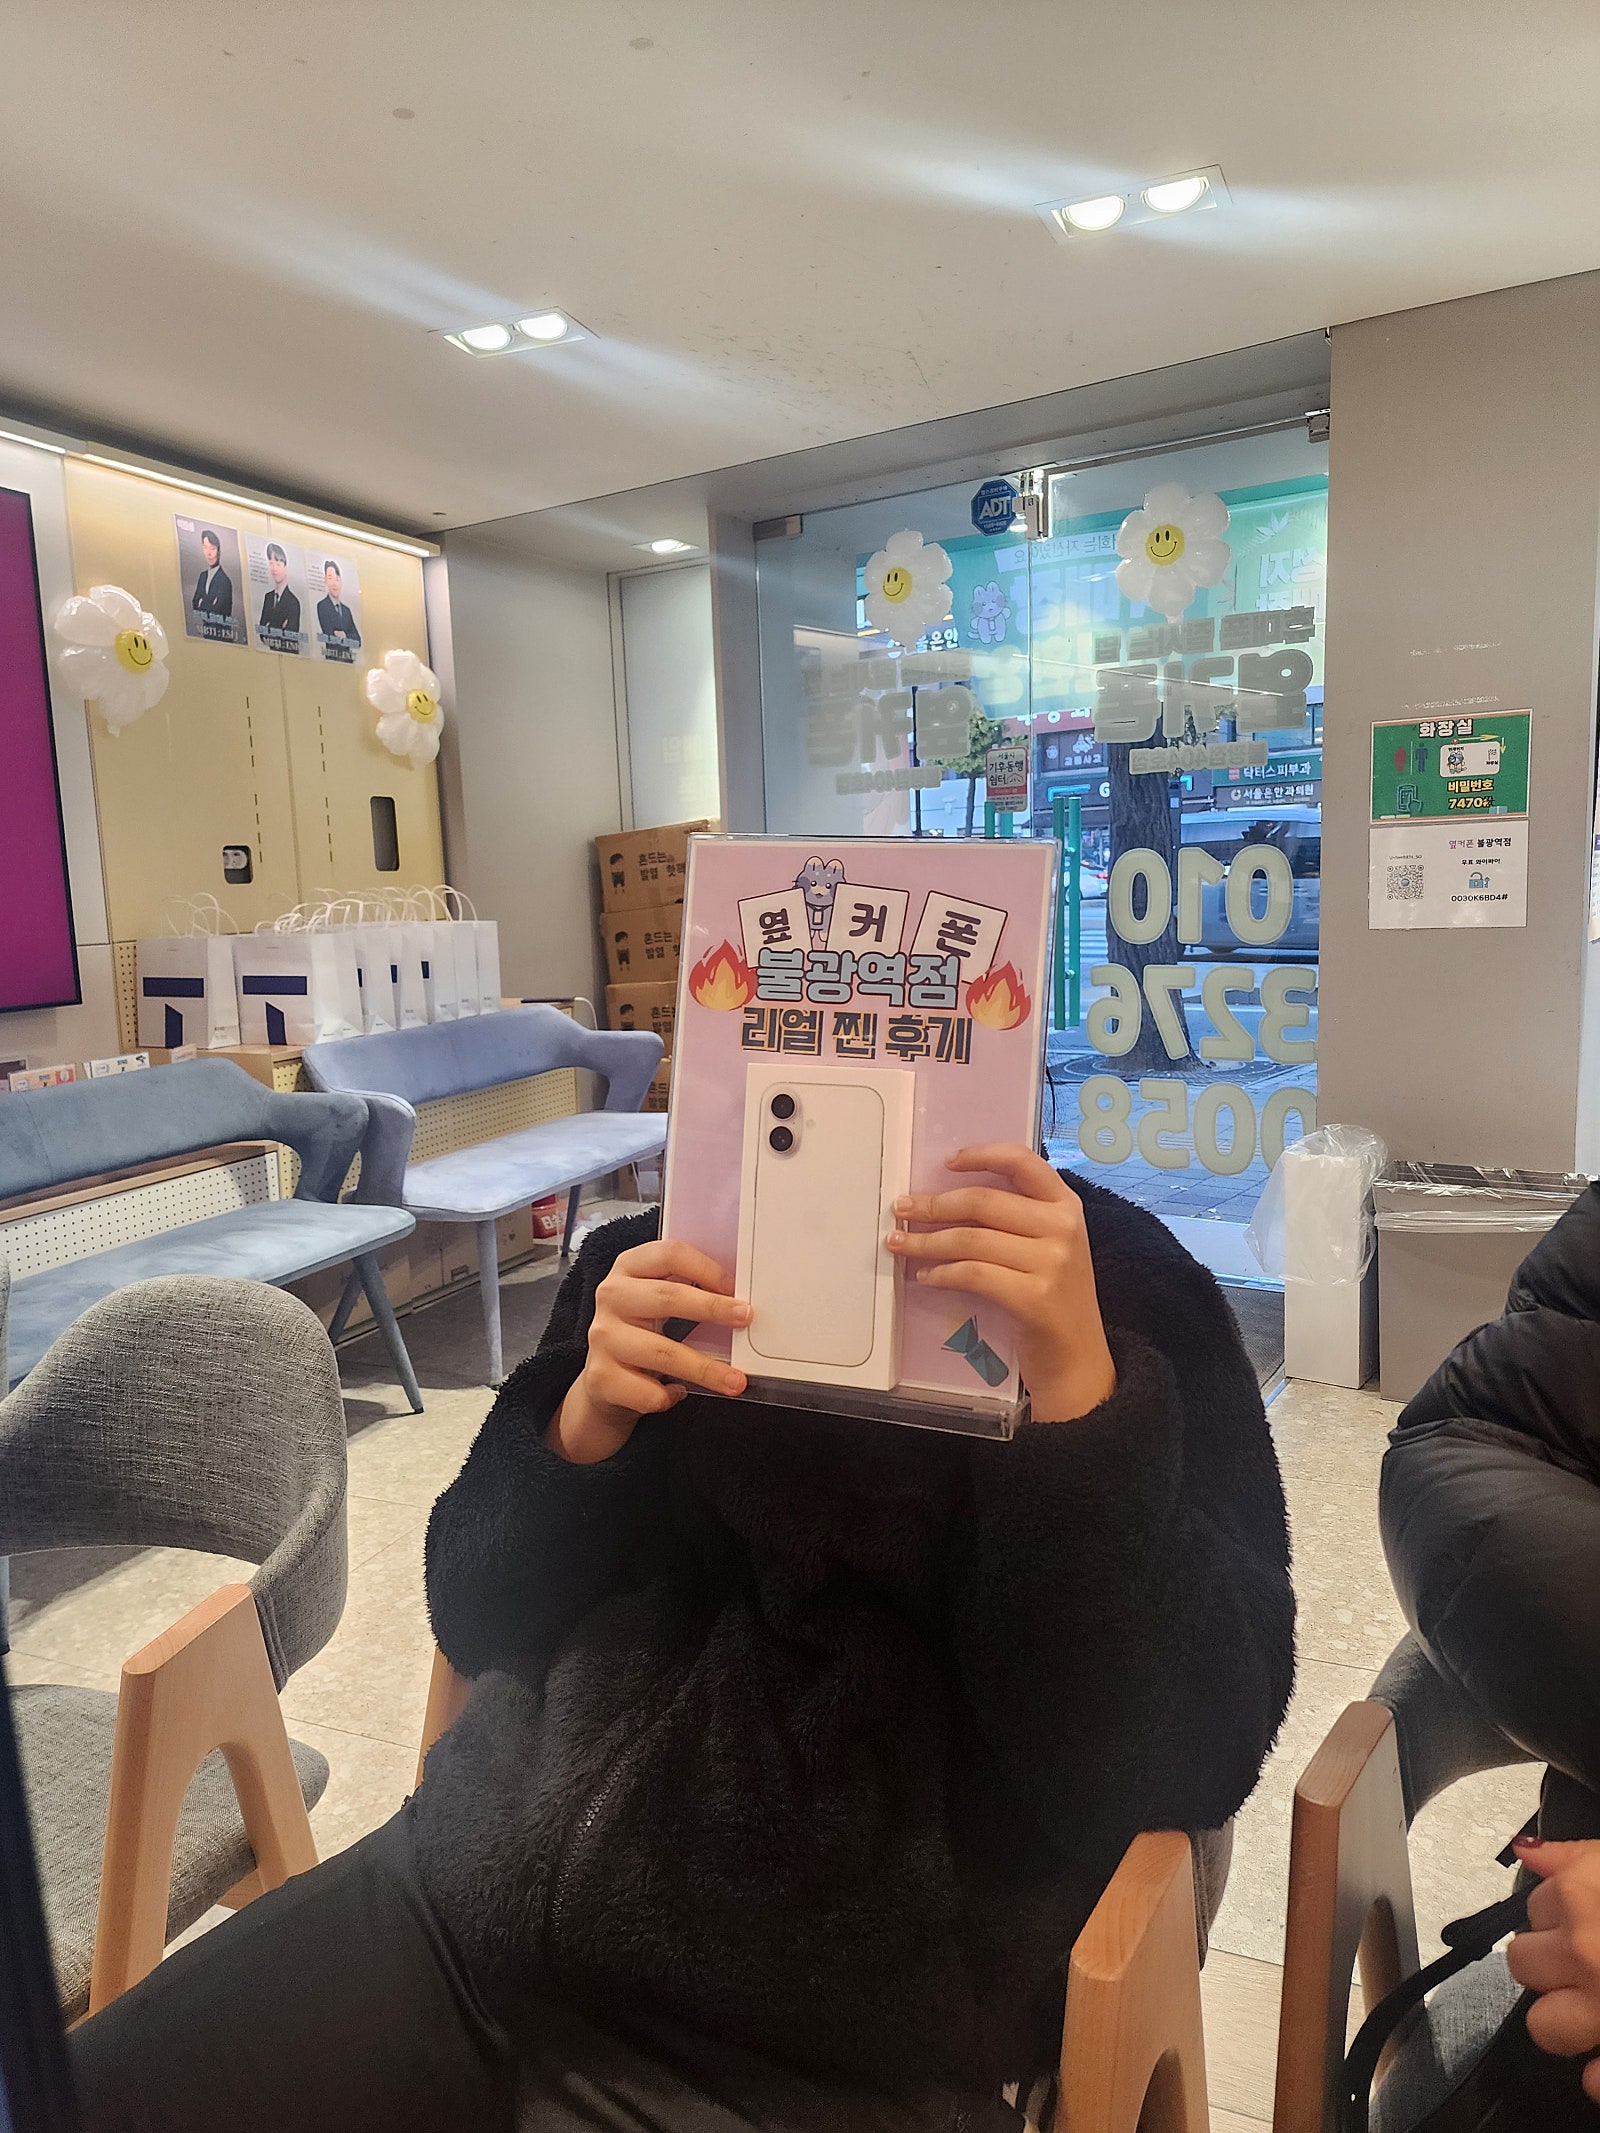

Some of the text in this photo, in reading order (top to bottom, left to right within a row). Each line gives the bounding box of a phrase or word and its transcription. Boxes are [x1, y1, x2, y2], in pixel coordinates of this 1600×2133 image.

[979, 496, 1010, 519] ADT
[1419, 718, 1473, 738] 화장실
[989, 760, 1024, 773] 기후동행
[1243, 761, 1312, 780] 닥터스피부과
[989, 774, 1008, 786] 쉼터
[1447, 779, 1494, 793] 비밀번호
[1243, 784, 1314, 800] 서울은안과의원
[1449, 838, 1512, 849] 옆커폰 불광역점
[756, 948, 960, 1010] 불광역점
[741, 1007, 973, 1065] 리얼 찐 후기
